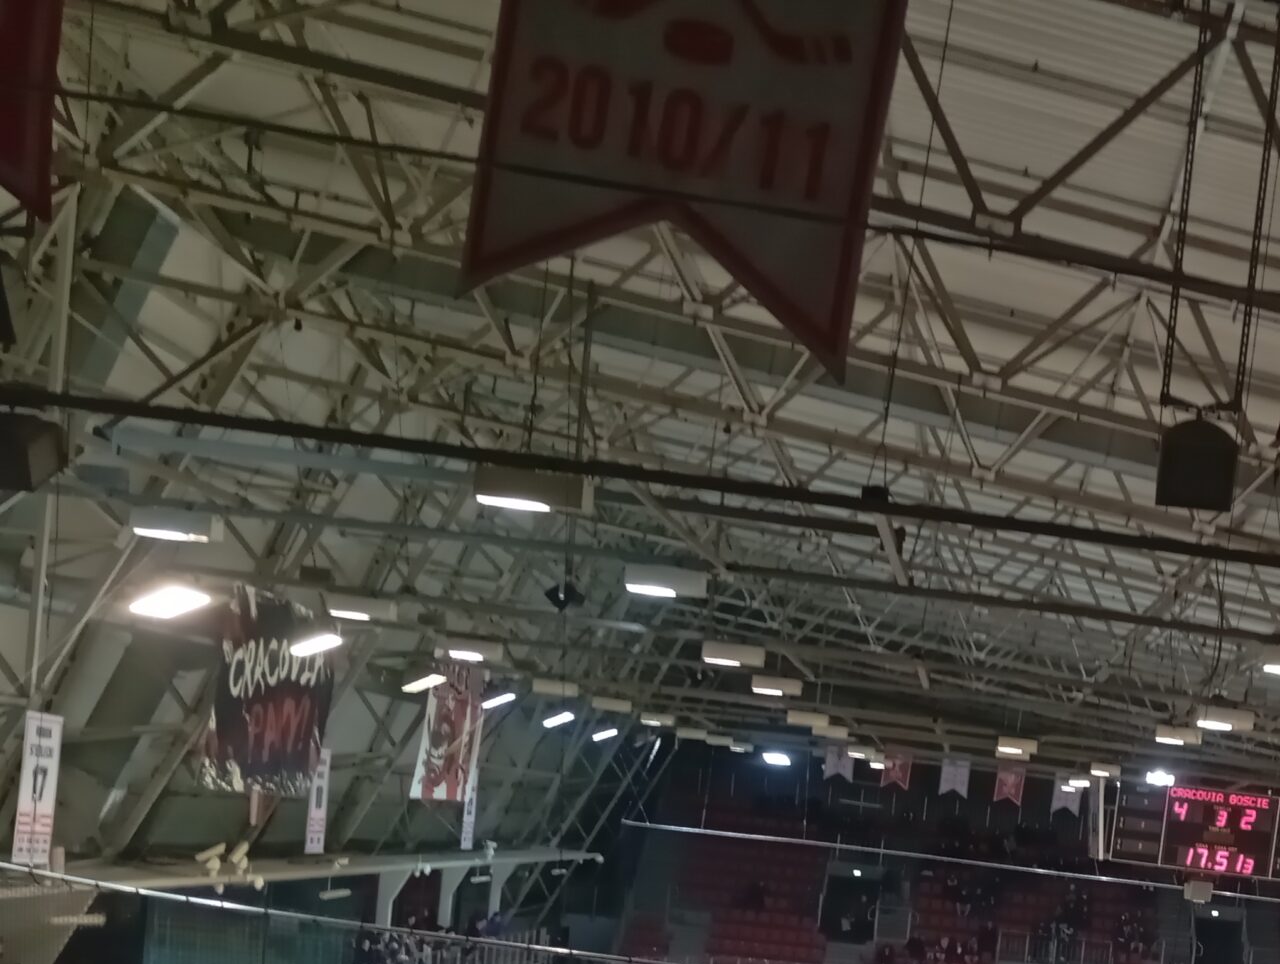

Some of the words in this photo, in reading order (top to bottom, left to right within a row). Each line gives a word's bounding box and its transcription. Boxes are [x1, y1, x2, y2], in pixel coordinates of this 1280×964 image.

[518, 54, 833, 202] 2010/11
[1170, 787, 1224, 803] CRACOVIA
[1173, 802, 1189, 821] 4
[1215, 811, 1227, 828] 3
[1240, 810, 1257, 831] 2
